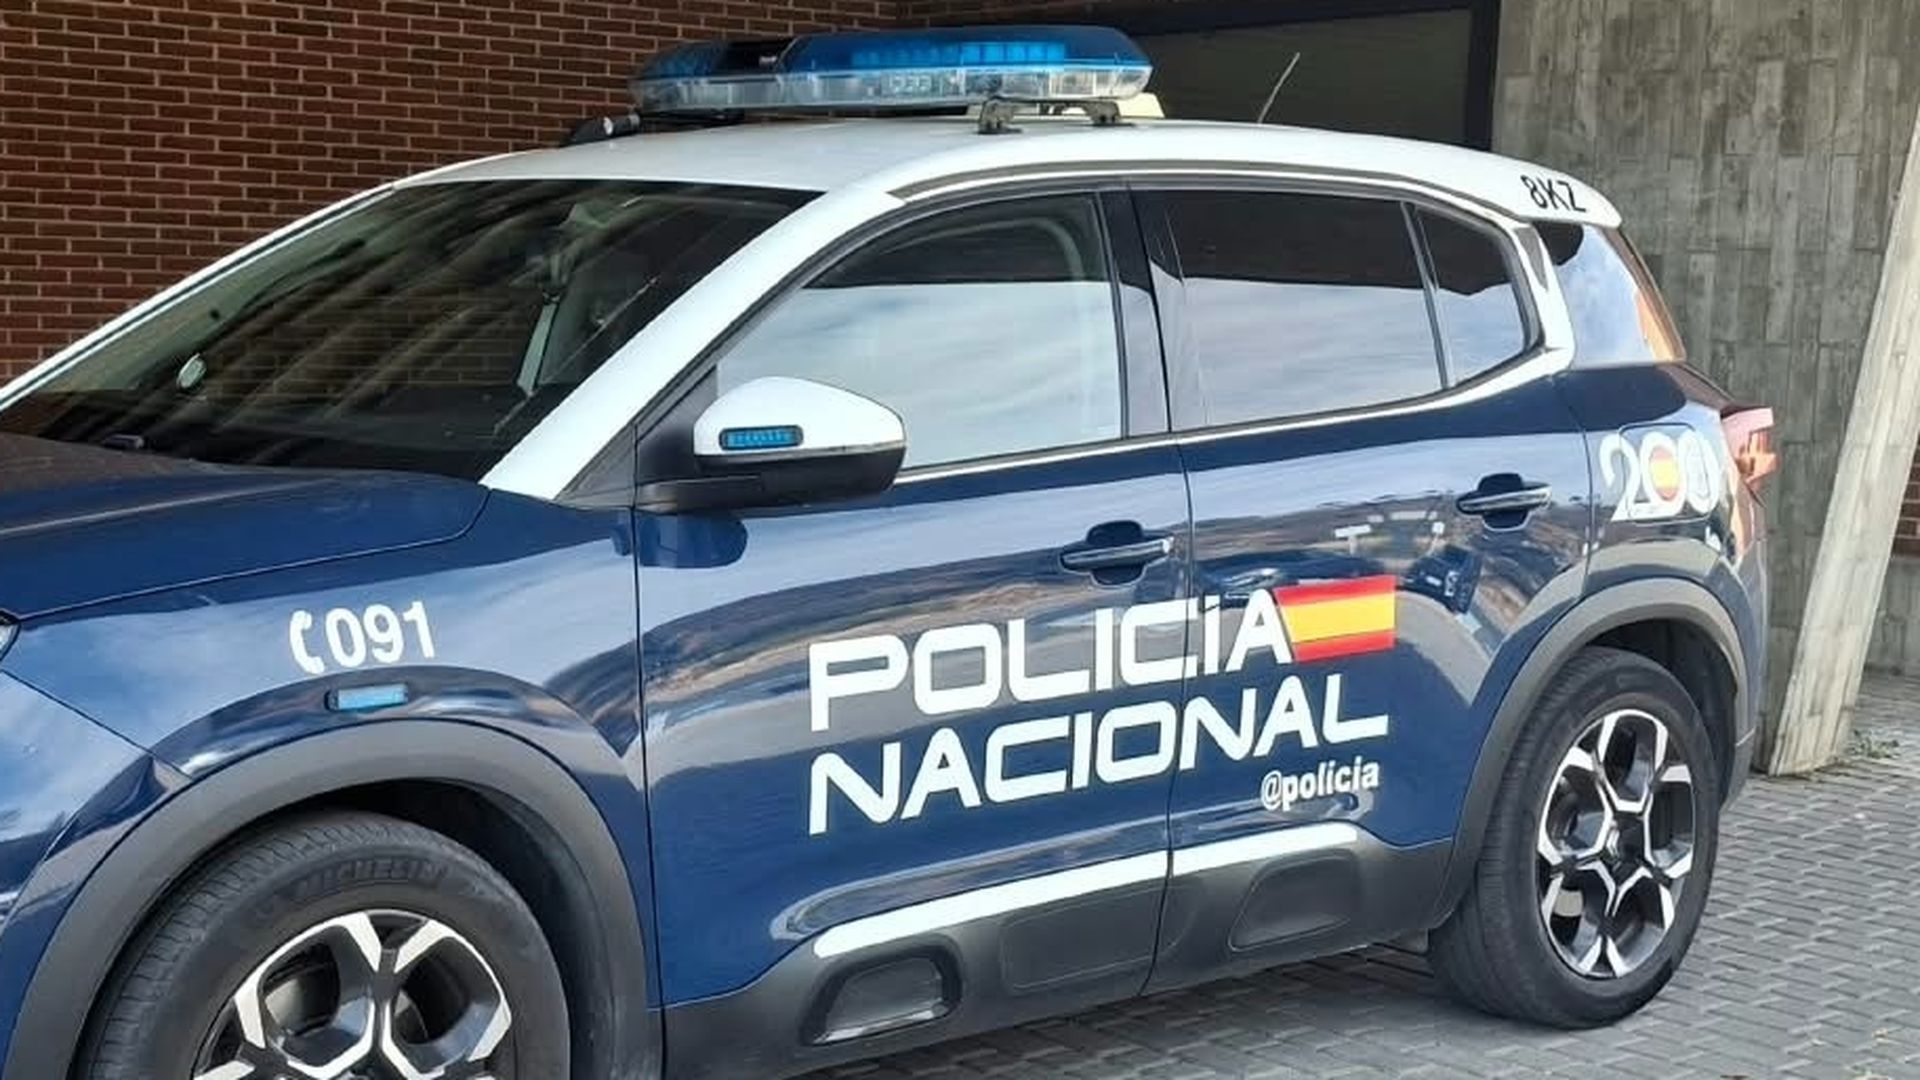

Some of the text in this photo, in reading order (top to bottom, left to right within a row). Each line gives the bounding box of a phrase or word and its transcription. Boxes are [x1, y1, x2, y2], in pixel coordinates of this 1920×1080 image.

[1520, 174, 1586, 213] 8KZ
[325, 600, 435, 668] 091
[809, 674, 1388, 835] NACIONAL
